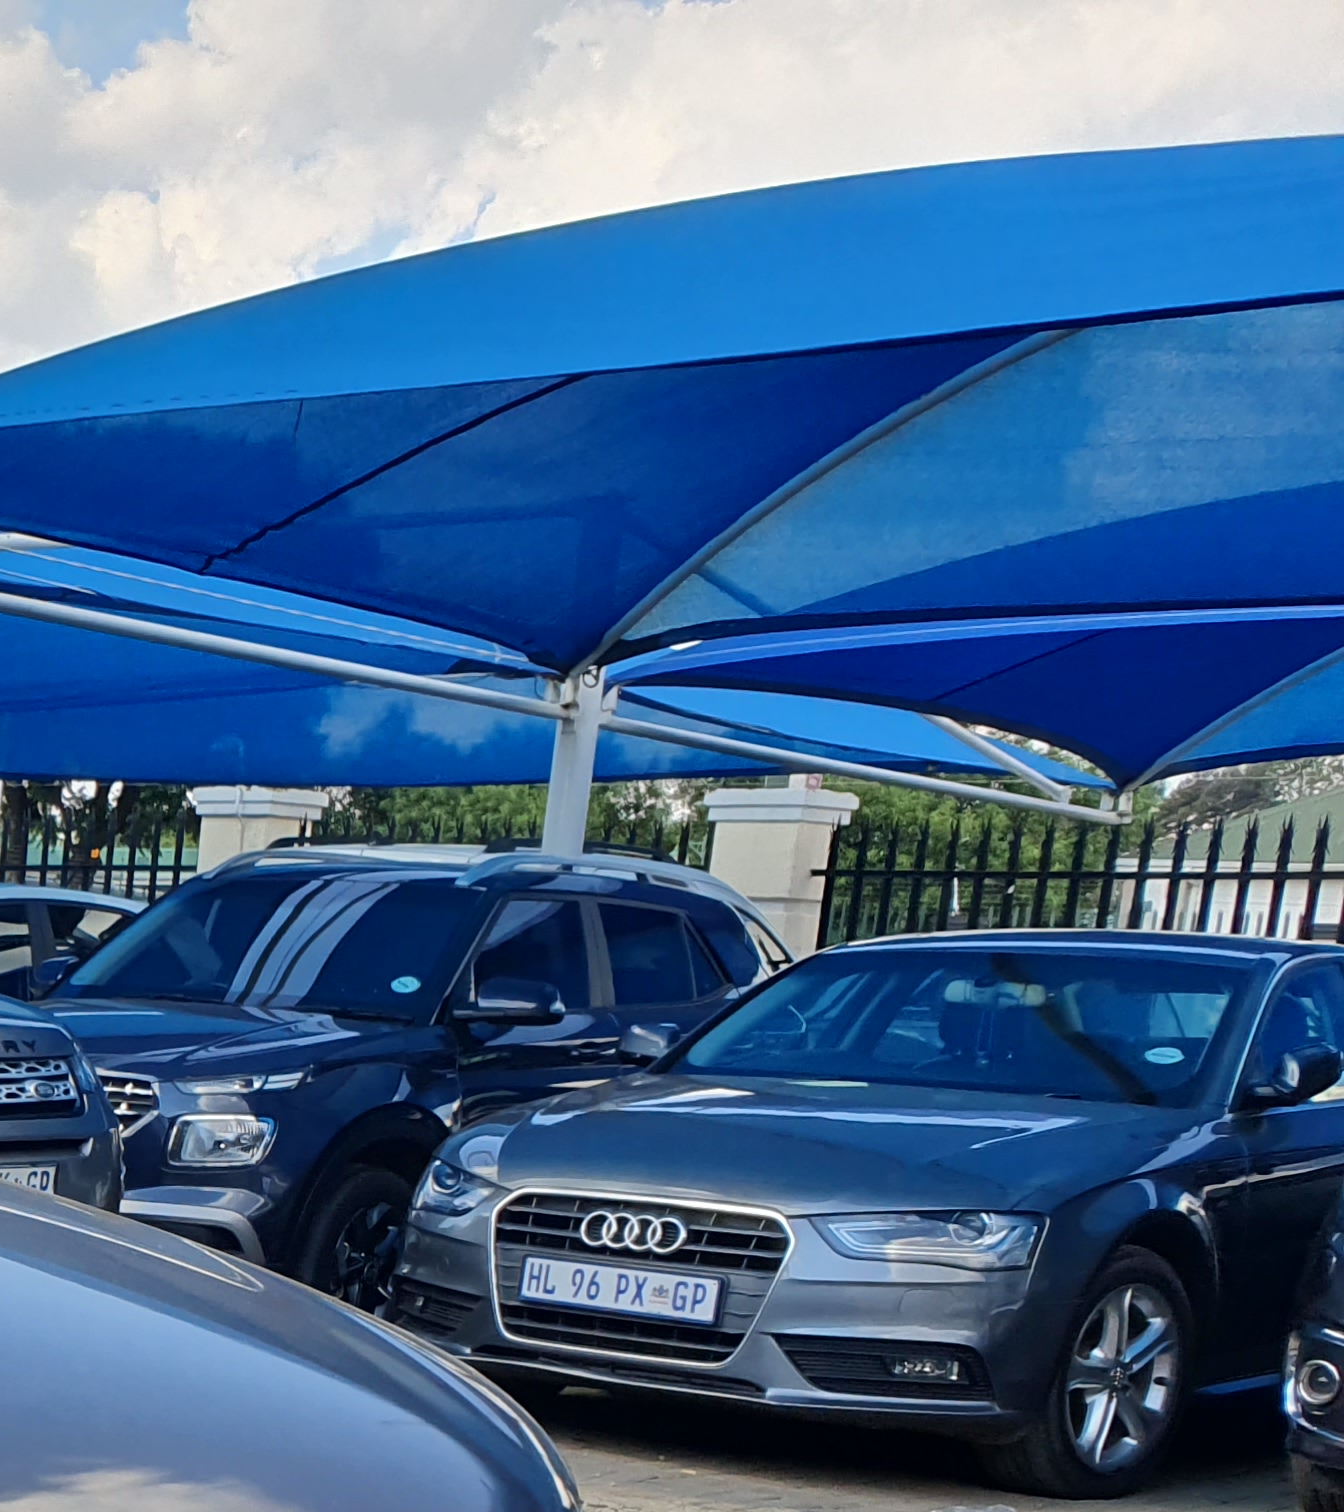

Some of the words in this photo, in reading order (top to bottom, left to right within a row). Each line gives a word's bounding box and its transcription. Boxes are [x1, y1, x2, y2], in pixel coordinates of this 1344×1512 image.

[526, 1261, 557, 1295] HL
[571, 1268, 601, 1301] 96
[614, 1273, 648, 1307] PX
[672, 1281, 707, 1314] GP
